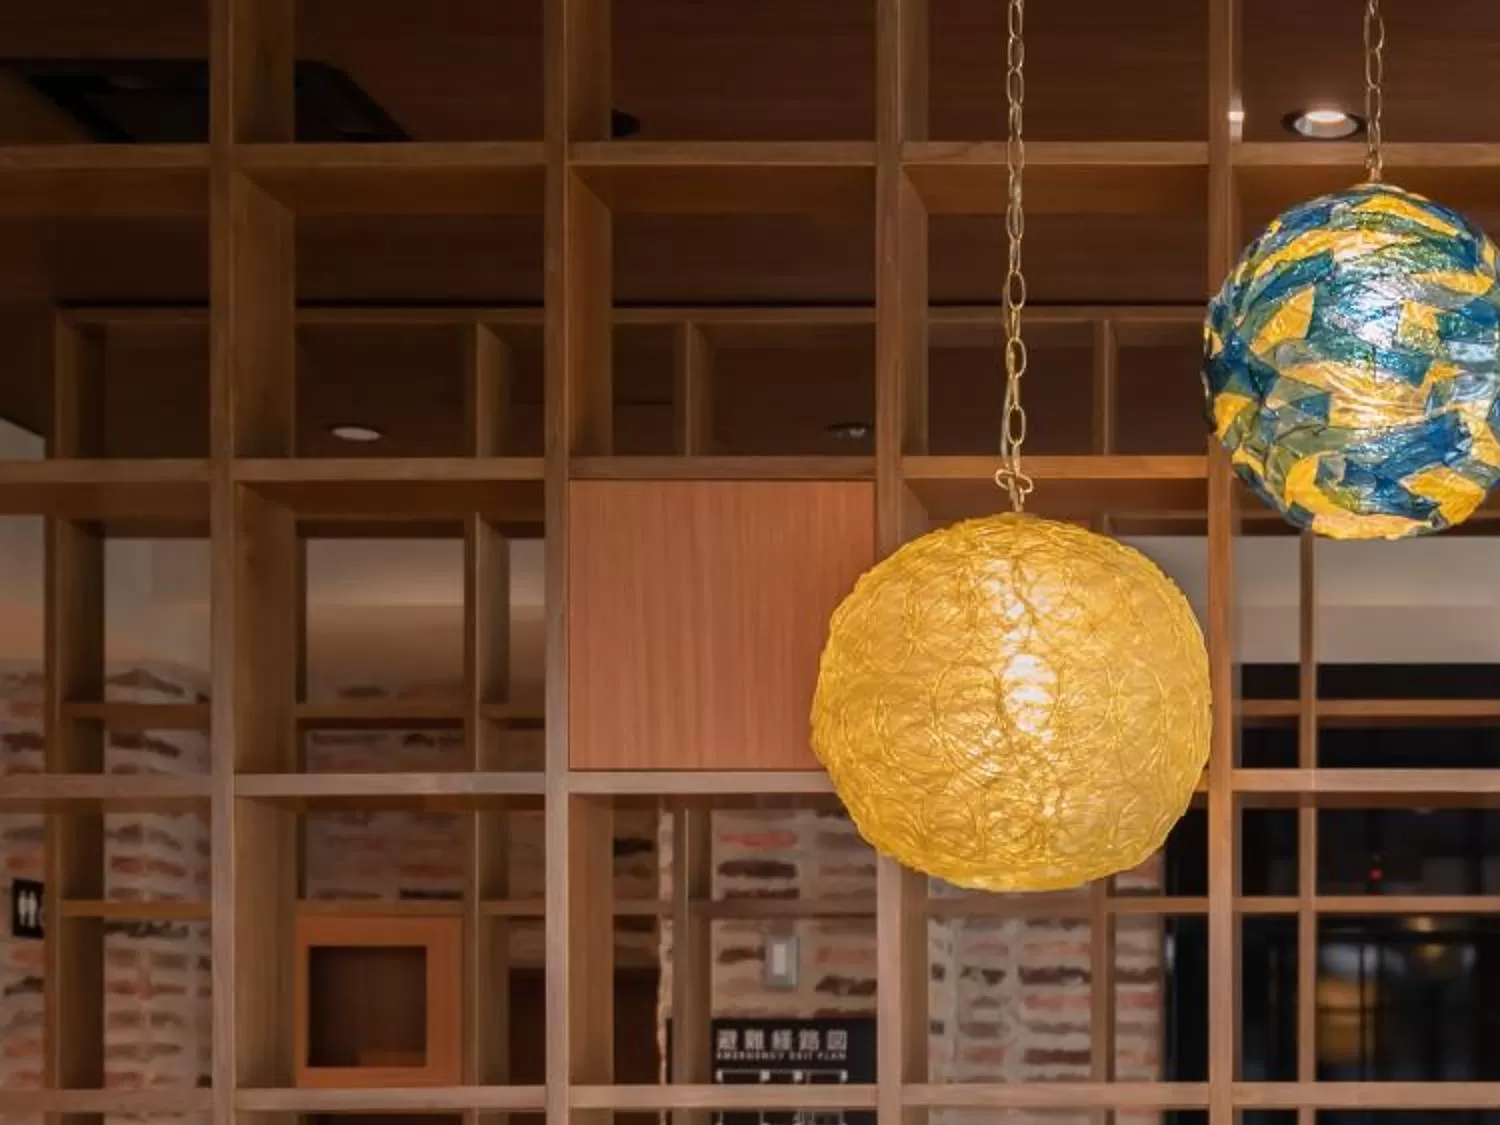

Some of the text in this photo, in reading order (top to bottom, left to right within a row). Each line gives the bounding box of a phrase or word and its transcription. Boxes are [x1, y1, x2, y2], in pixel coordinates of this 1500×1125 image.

[716, 1051, 847, 1061] EMERGENCY EXIT PLAN
